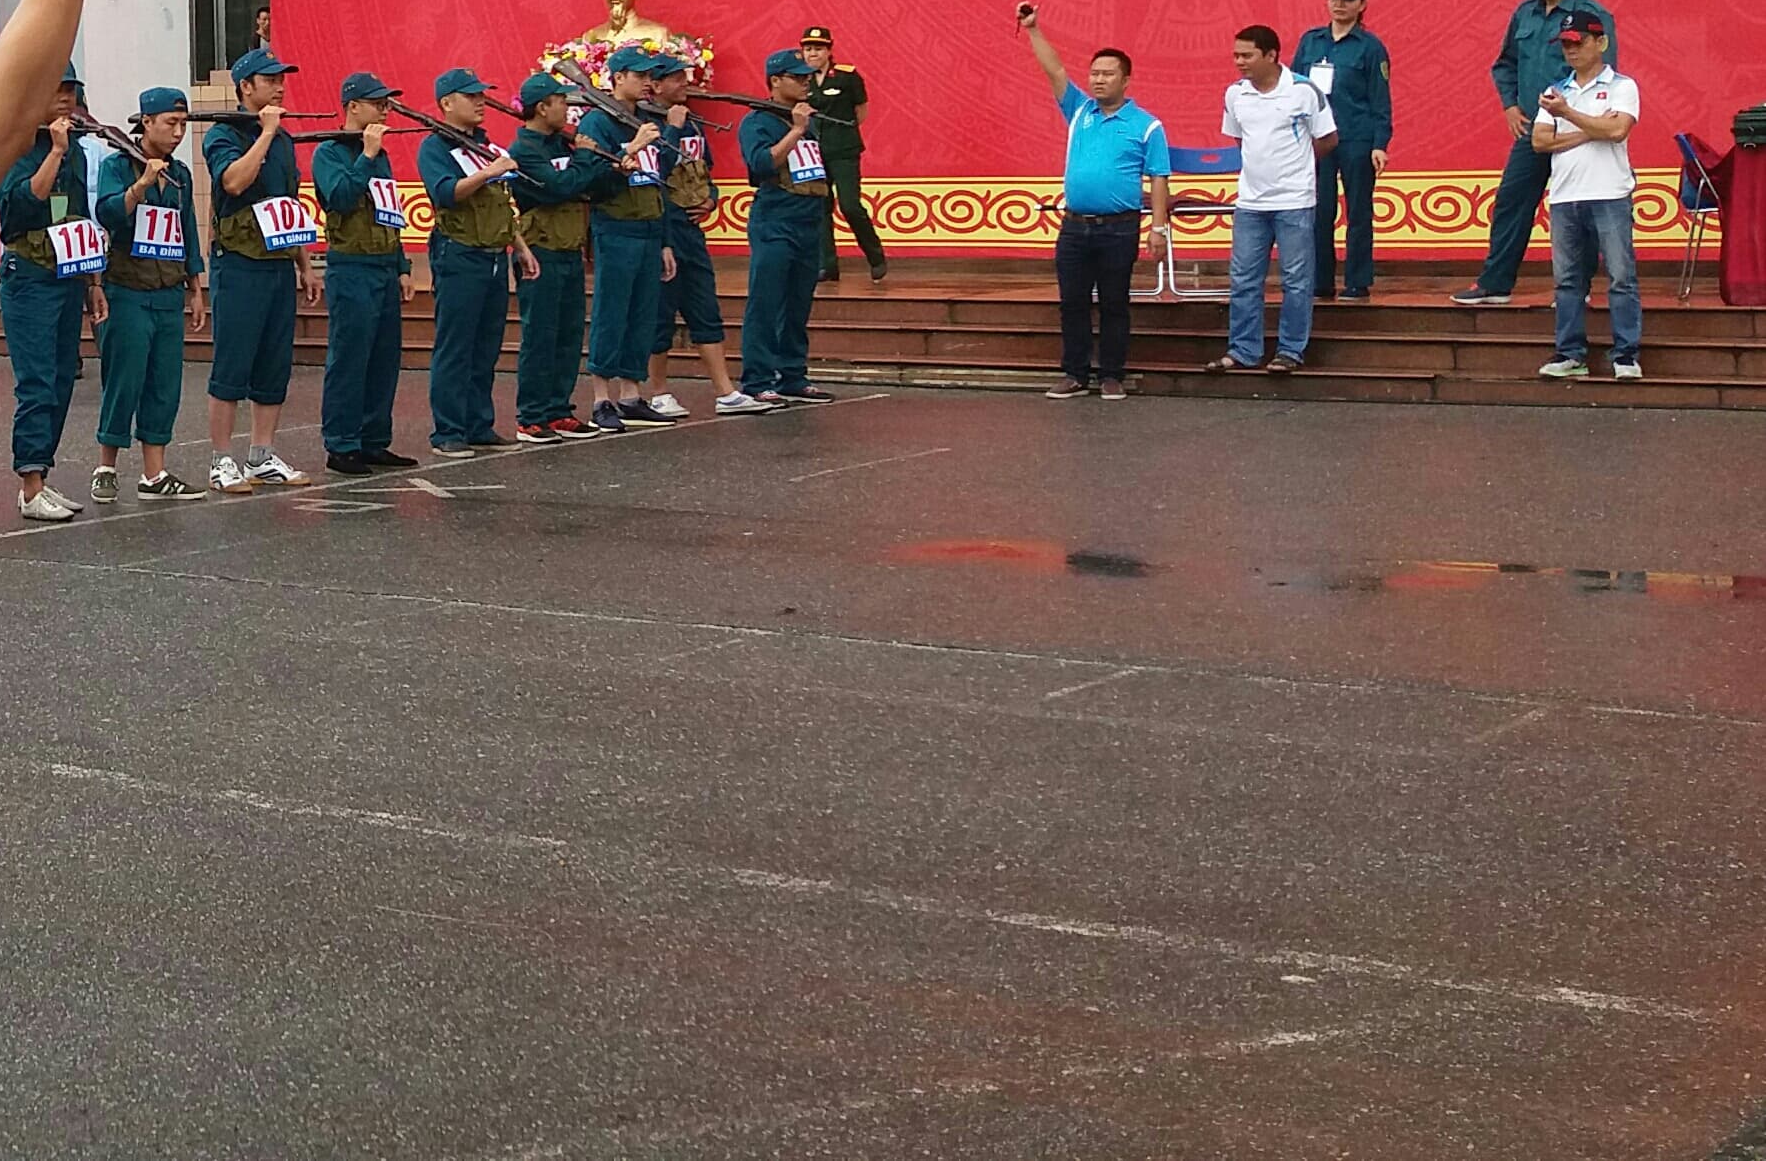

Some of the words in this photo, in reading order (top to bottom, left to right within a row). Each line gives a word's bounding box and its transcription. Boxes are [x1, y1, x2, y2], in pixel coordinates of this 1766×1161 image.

[374, 181, 402, 213] 11
[264, 200, 305, 232] 107
[58, 223, 99, 259] 114
[138, 244, 156, 255] BA
[271, 236, 285, 247] BA
[62, 263, 78, 275] BA
